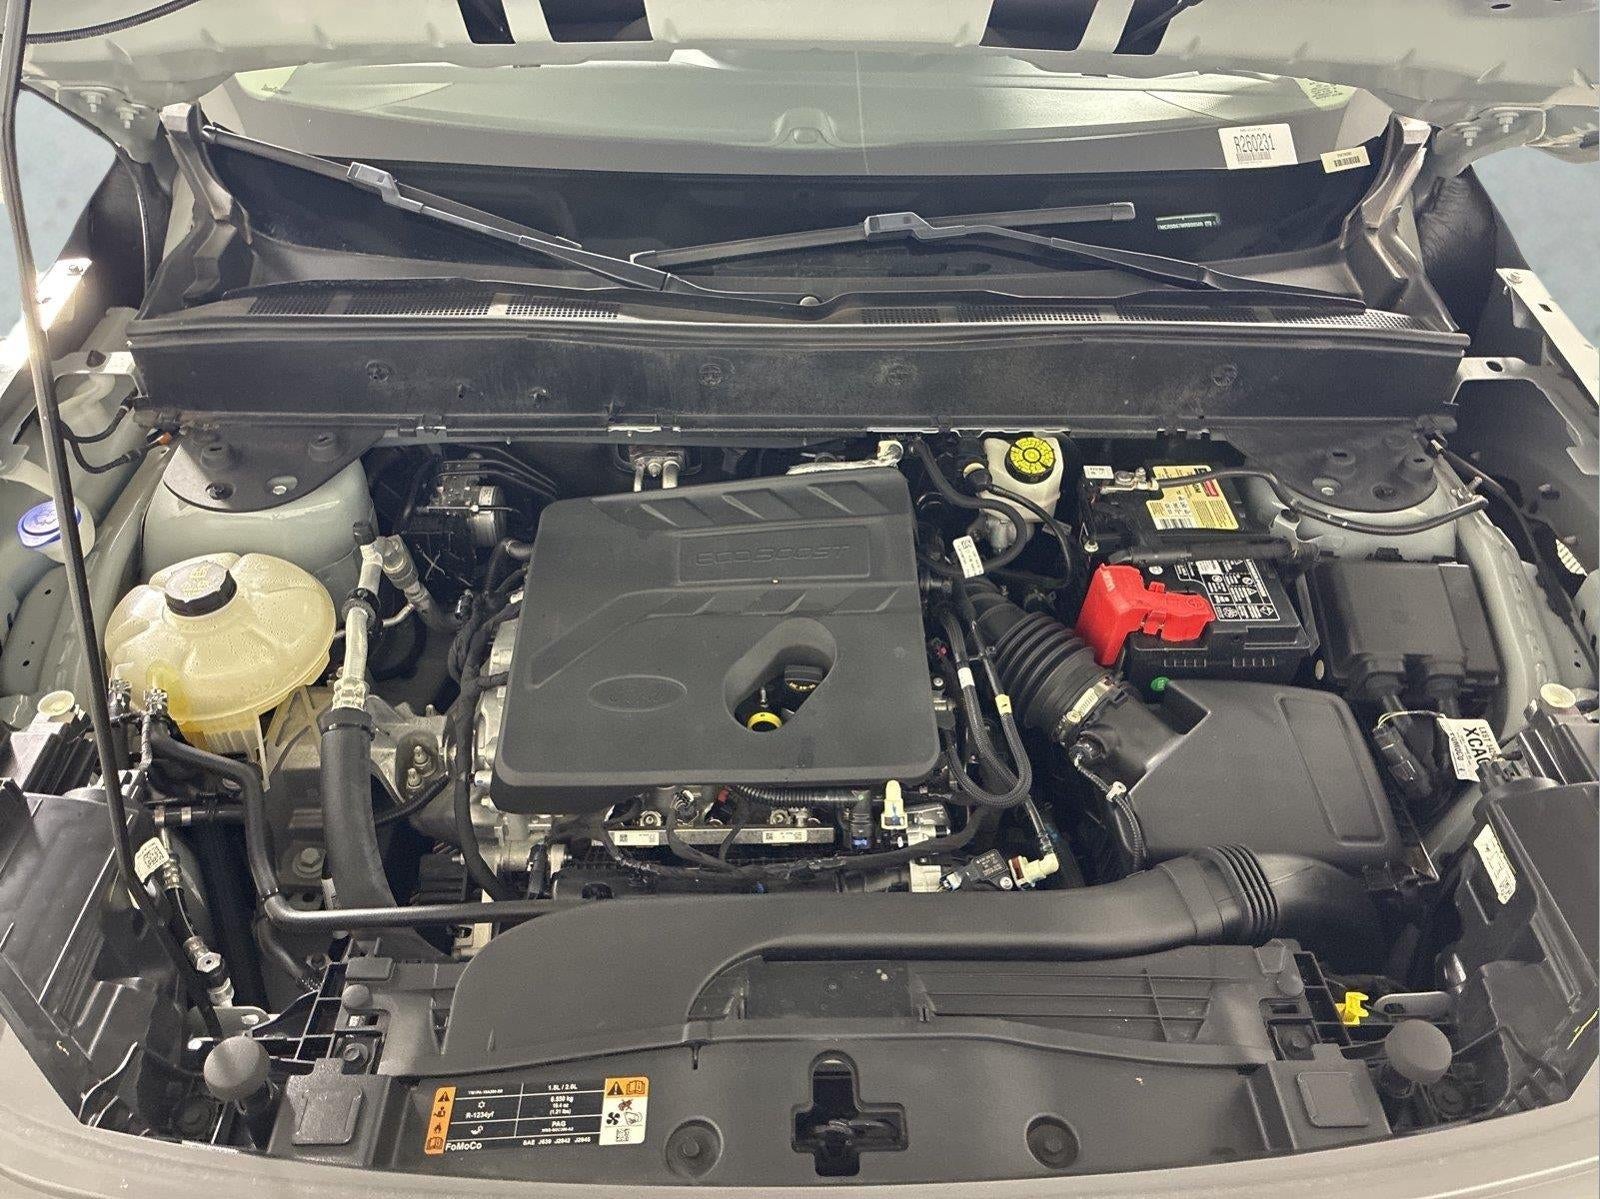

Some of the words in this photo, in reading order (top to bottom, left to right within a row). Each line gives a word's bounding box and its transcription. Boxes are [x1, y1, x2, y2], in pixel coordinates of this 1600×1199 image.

[1233, 132, 1275, 152] R260231
[465, 1111, 495, 1119] R-1234yf
[551, 1120, 567, 1128] PAG
[445, 1141, 482, 1151] FoMoCo
